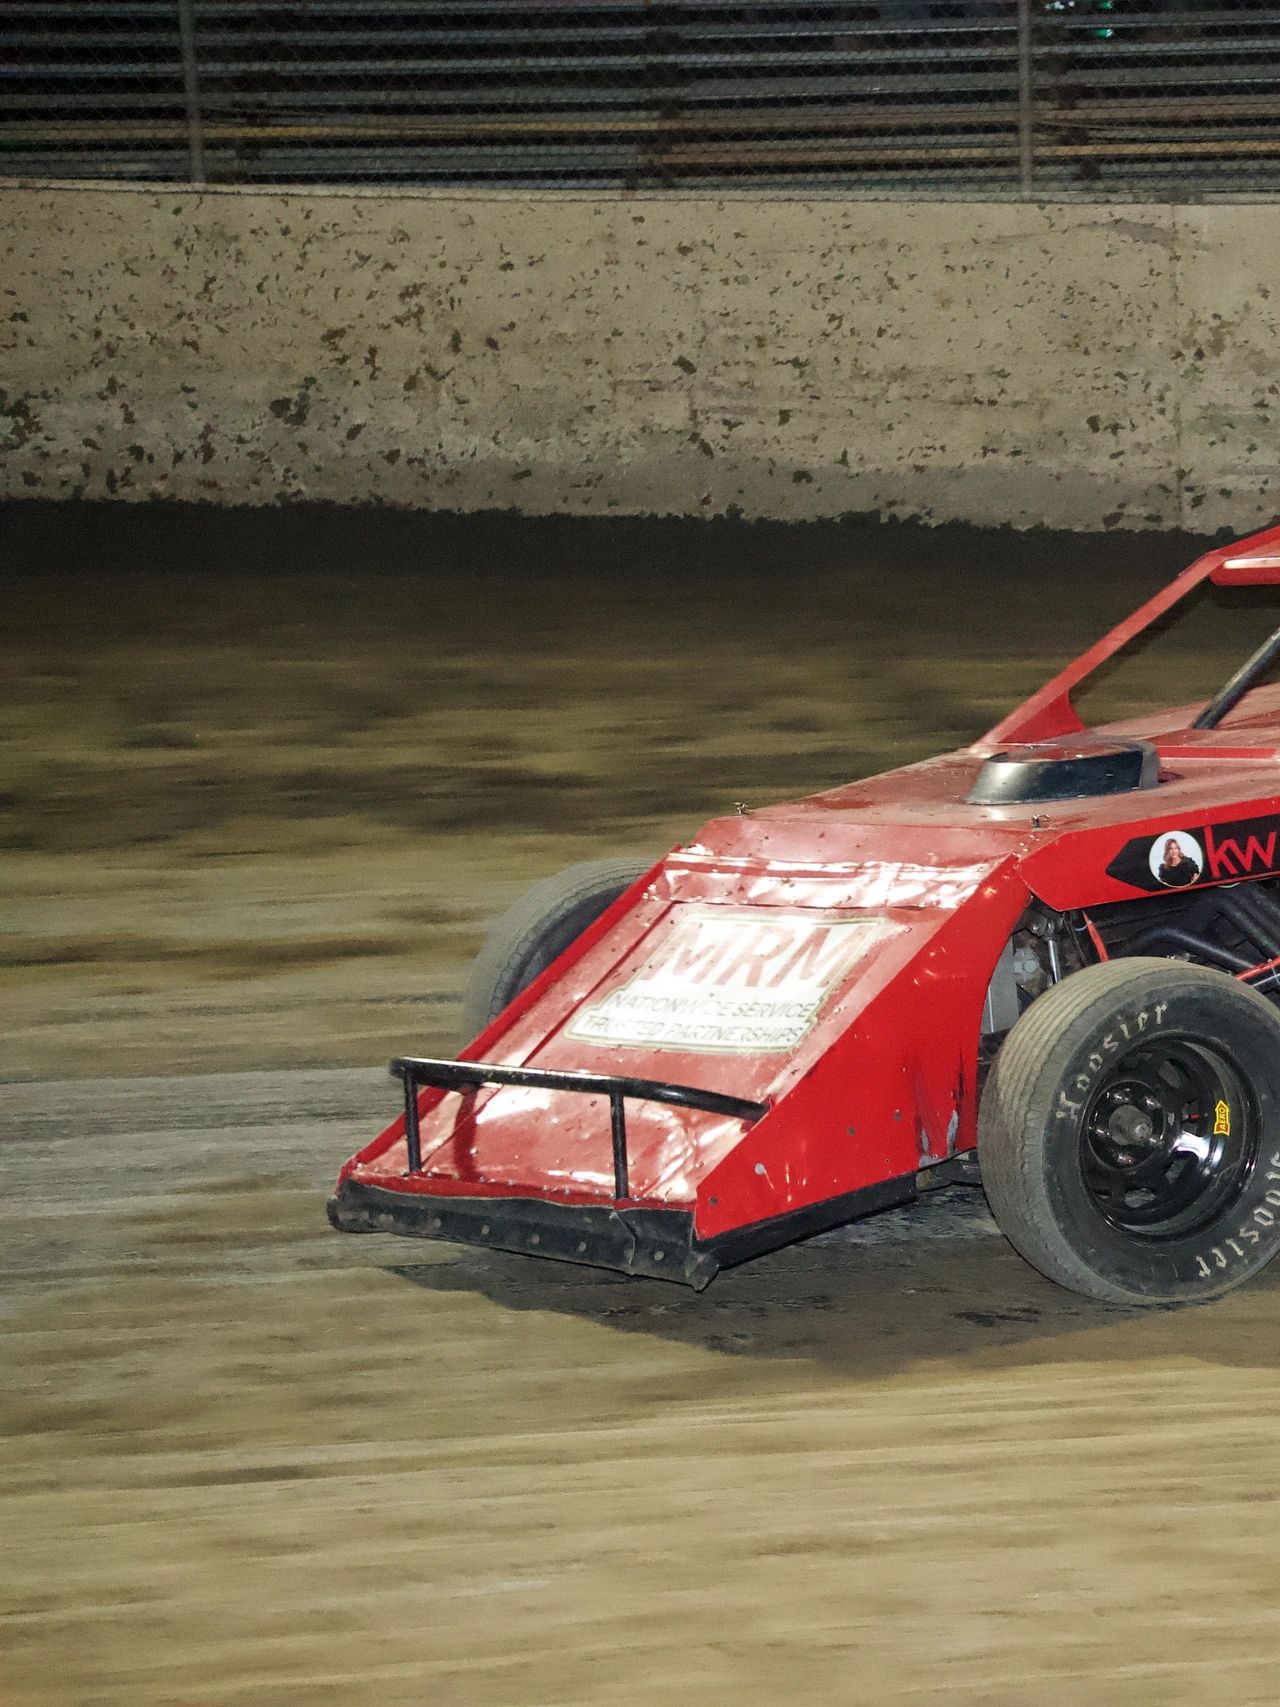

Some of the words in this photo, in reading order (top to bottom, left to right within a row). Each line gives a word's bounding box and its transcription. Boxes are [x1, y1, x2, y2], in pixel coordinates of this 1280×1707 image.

[640, 921, 877, 988] MRM
[732, 1000, 817, 1019] SERVICE
[666, 1022, 804, 1043] PARTNERSHIPS
